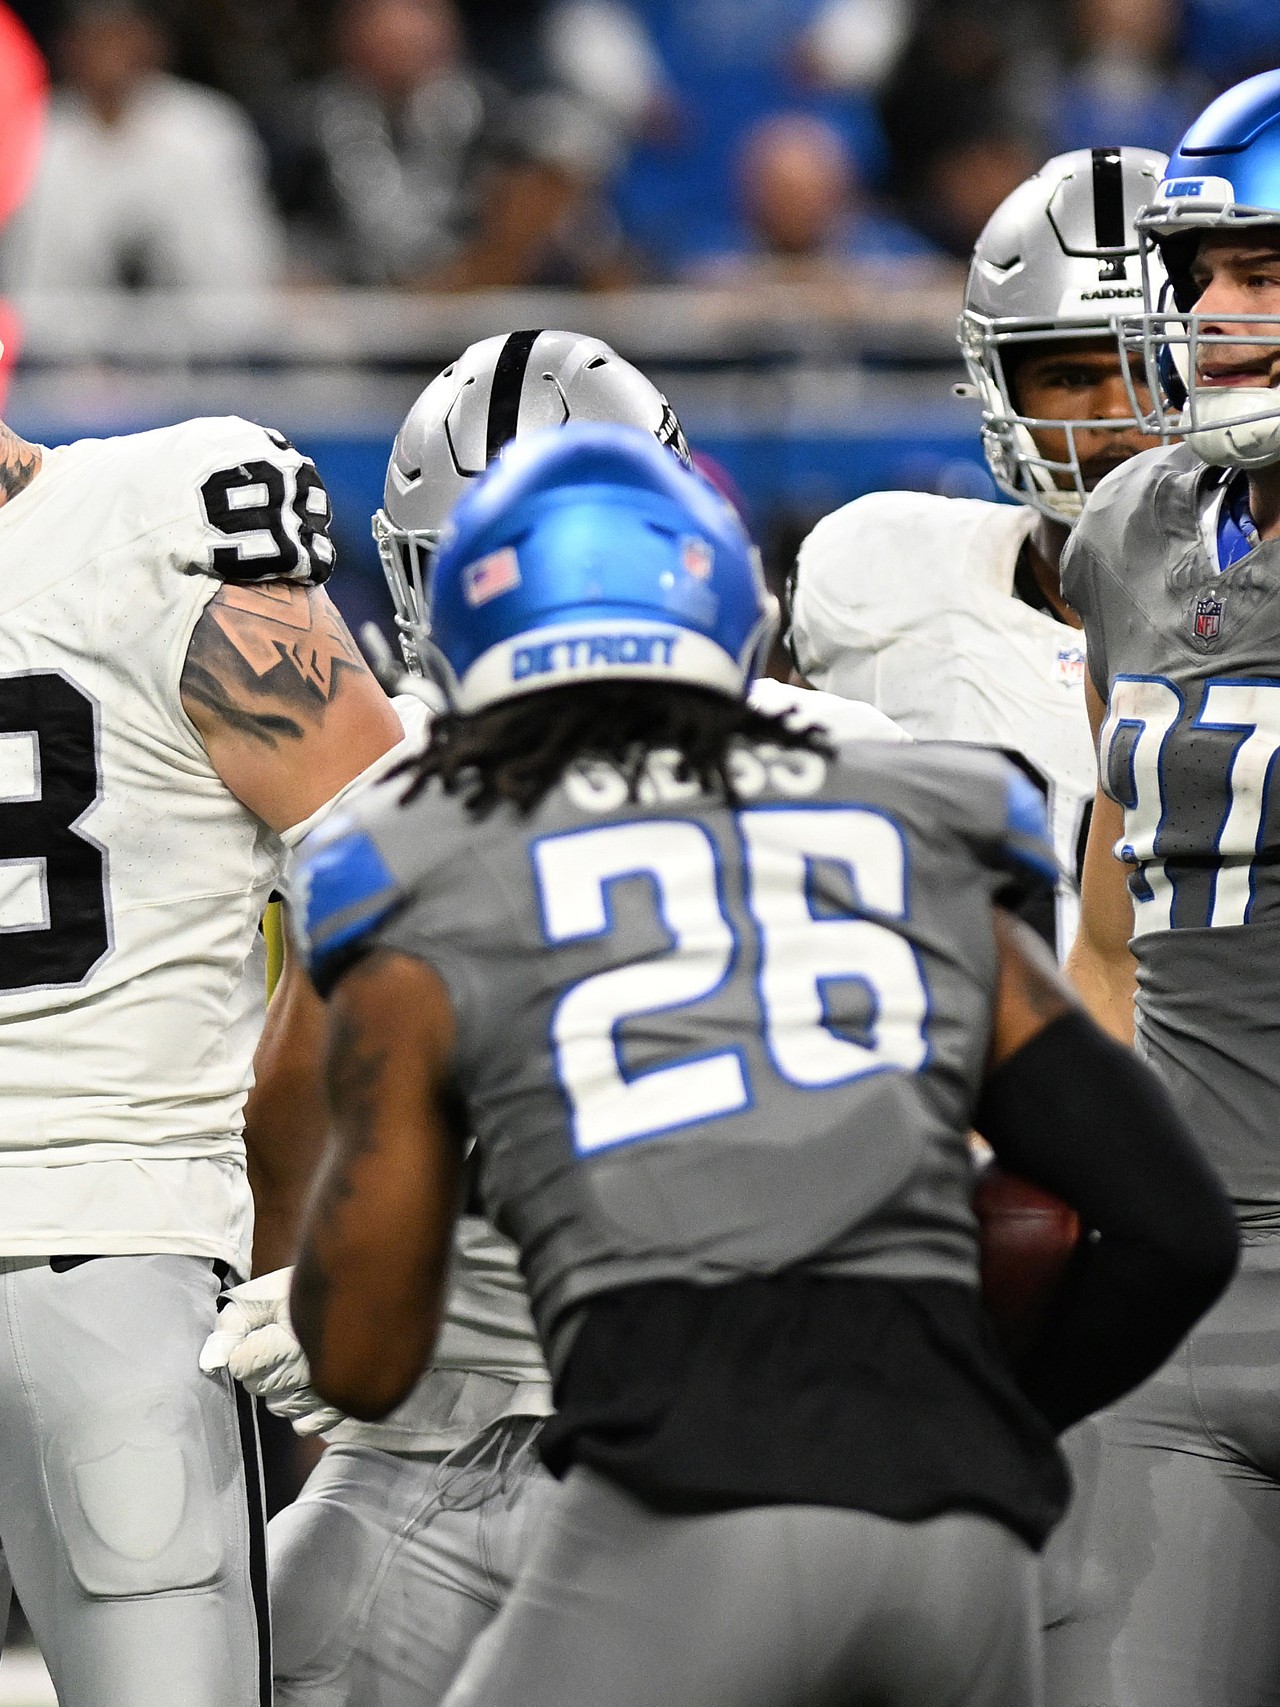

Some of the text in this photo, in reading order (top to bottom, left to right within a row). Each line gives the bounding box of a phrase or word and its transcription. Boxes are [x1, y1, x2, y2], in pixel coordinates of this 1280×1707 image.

[195, 458, 337, 585] 98
[513, 636, 677, 682] DETROIT
[1197, 615, 1219, 636] NFL
[1099, 673, 1280, 940] 97
[531, 803, 933, 1160] 26
